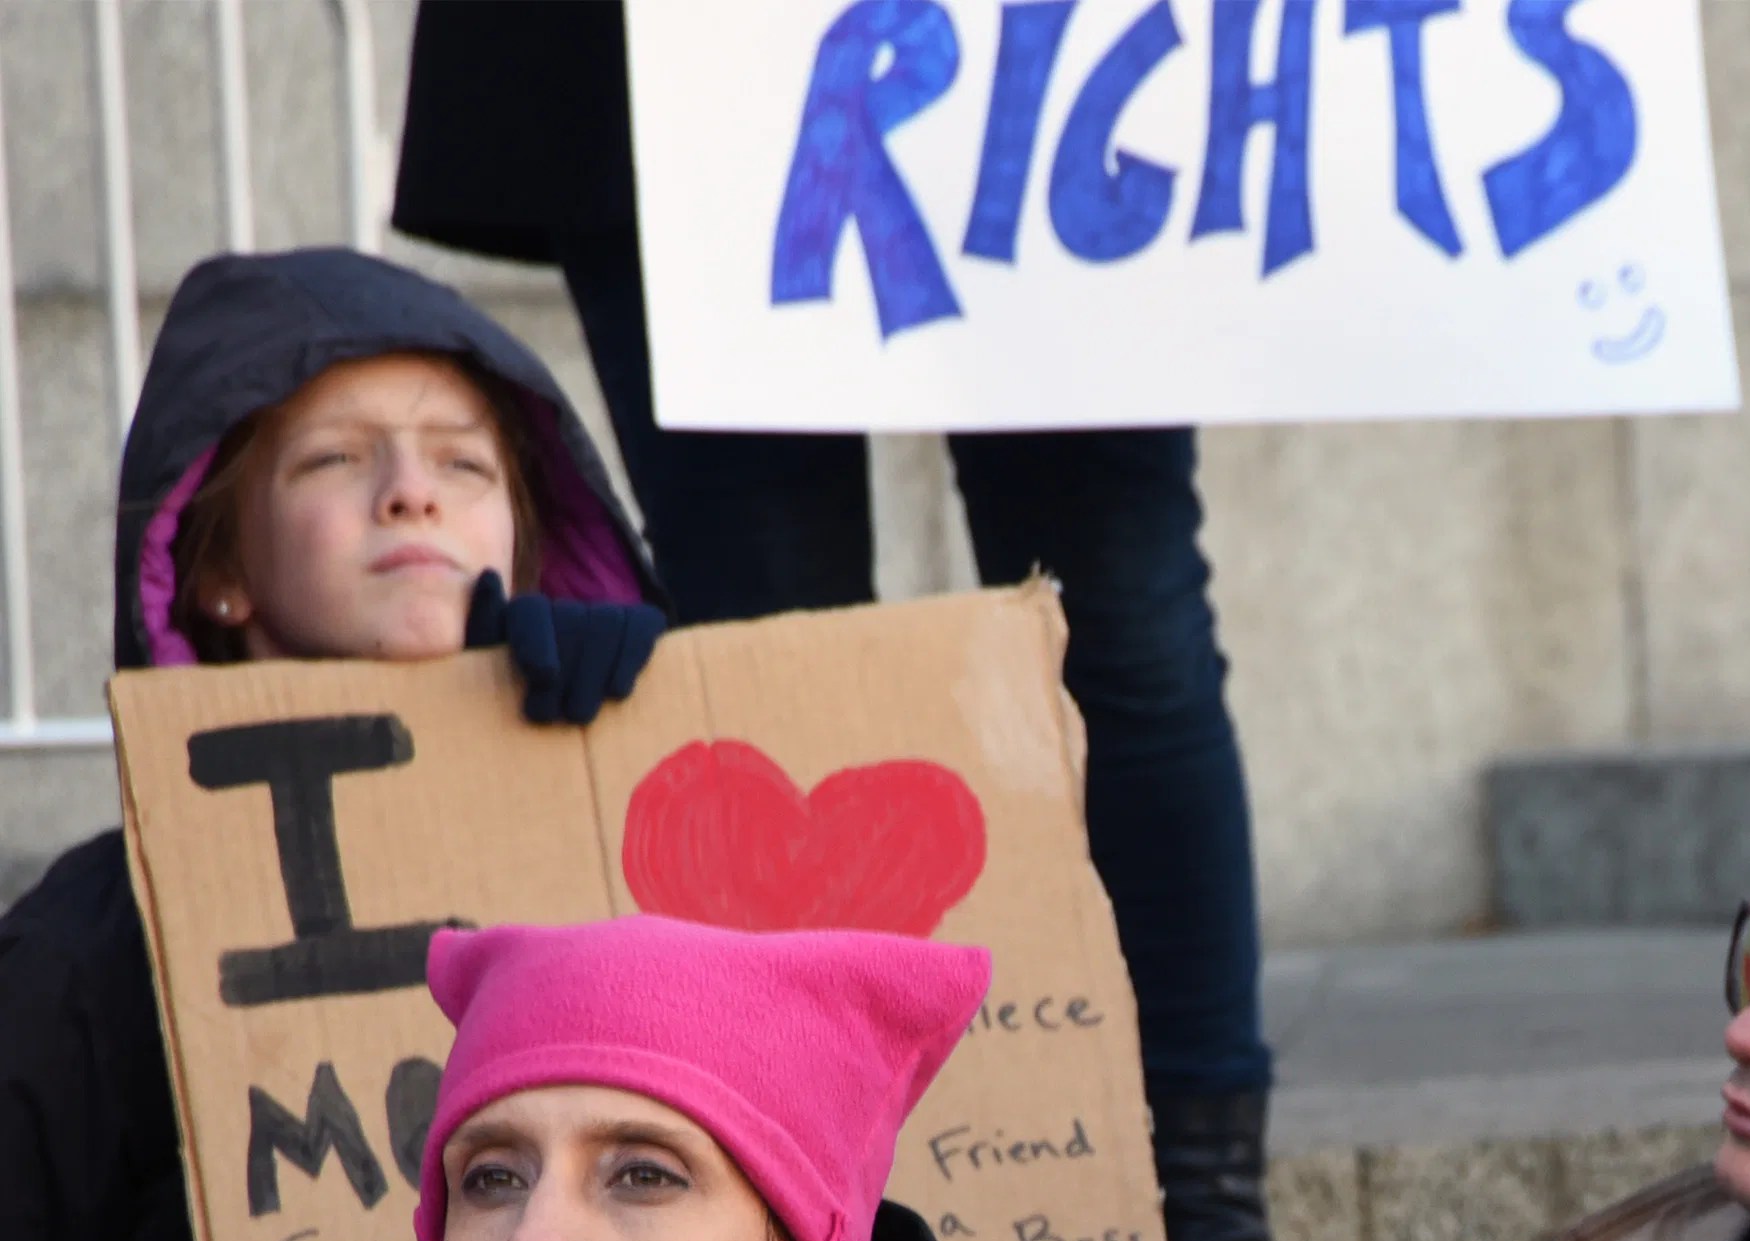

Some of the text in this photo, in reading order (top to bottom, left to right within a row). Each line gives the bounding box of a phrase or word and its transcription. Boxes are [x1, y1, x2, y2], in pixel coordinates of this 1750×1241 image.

[769, 0, 1640, 346] RIGHTS
[187, 712, 479, 1009] I
[966, 997, 1104, 1035] iece
[928, 1117, 1096, 1183] Friend
